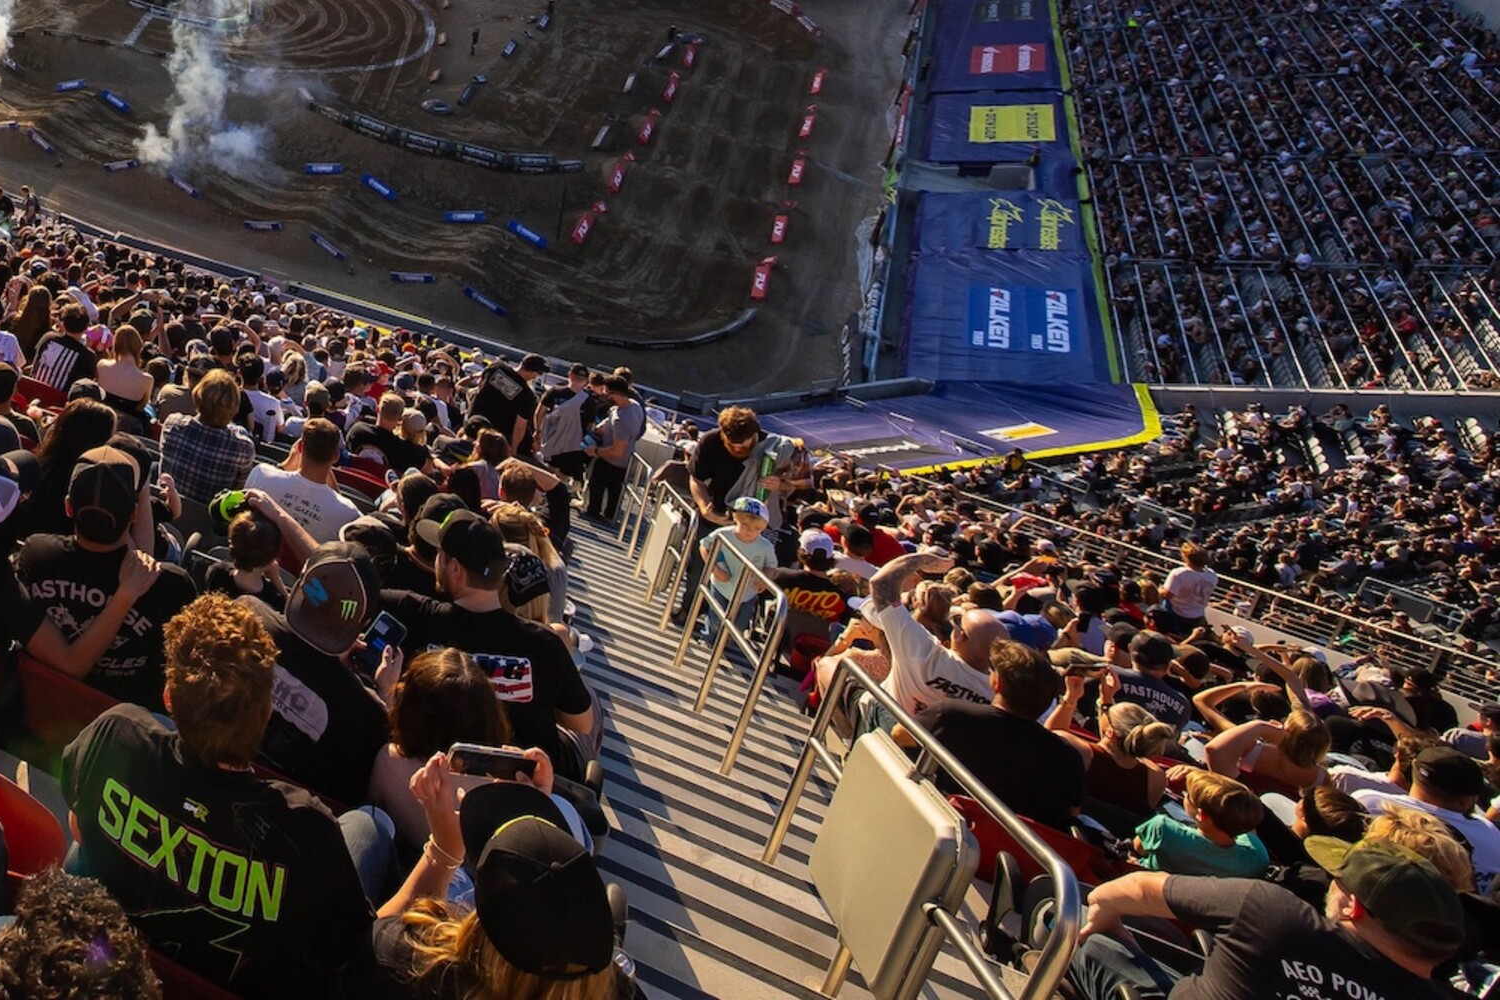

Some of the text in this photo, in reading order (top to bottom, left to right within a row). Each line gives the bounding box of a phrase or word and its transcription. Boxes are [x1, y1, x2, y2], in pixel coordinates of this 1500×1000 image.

[988, 288, 1010, 349] FALKEN
[1045, 290, 1070, 353] FALKEN
[31, 579, 153, 637] ASTHOSE
[783, 587, 842, 610] MOTO
[1122, 682, 1186, 716] FASTHOUSE
[97, 776, 287, 923] SEXTON
[1280, 958, 1324, 985] AEO
